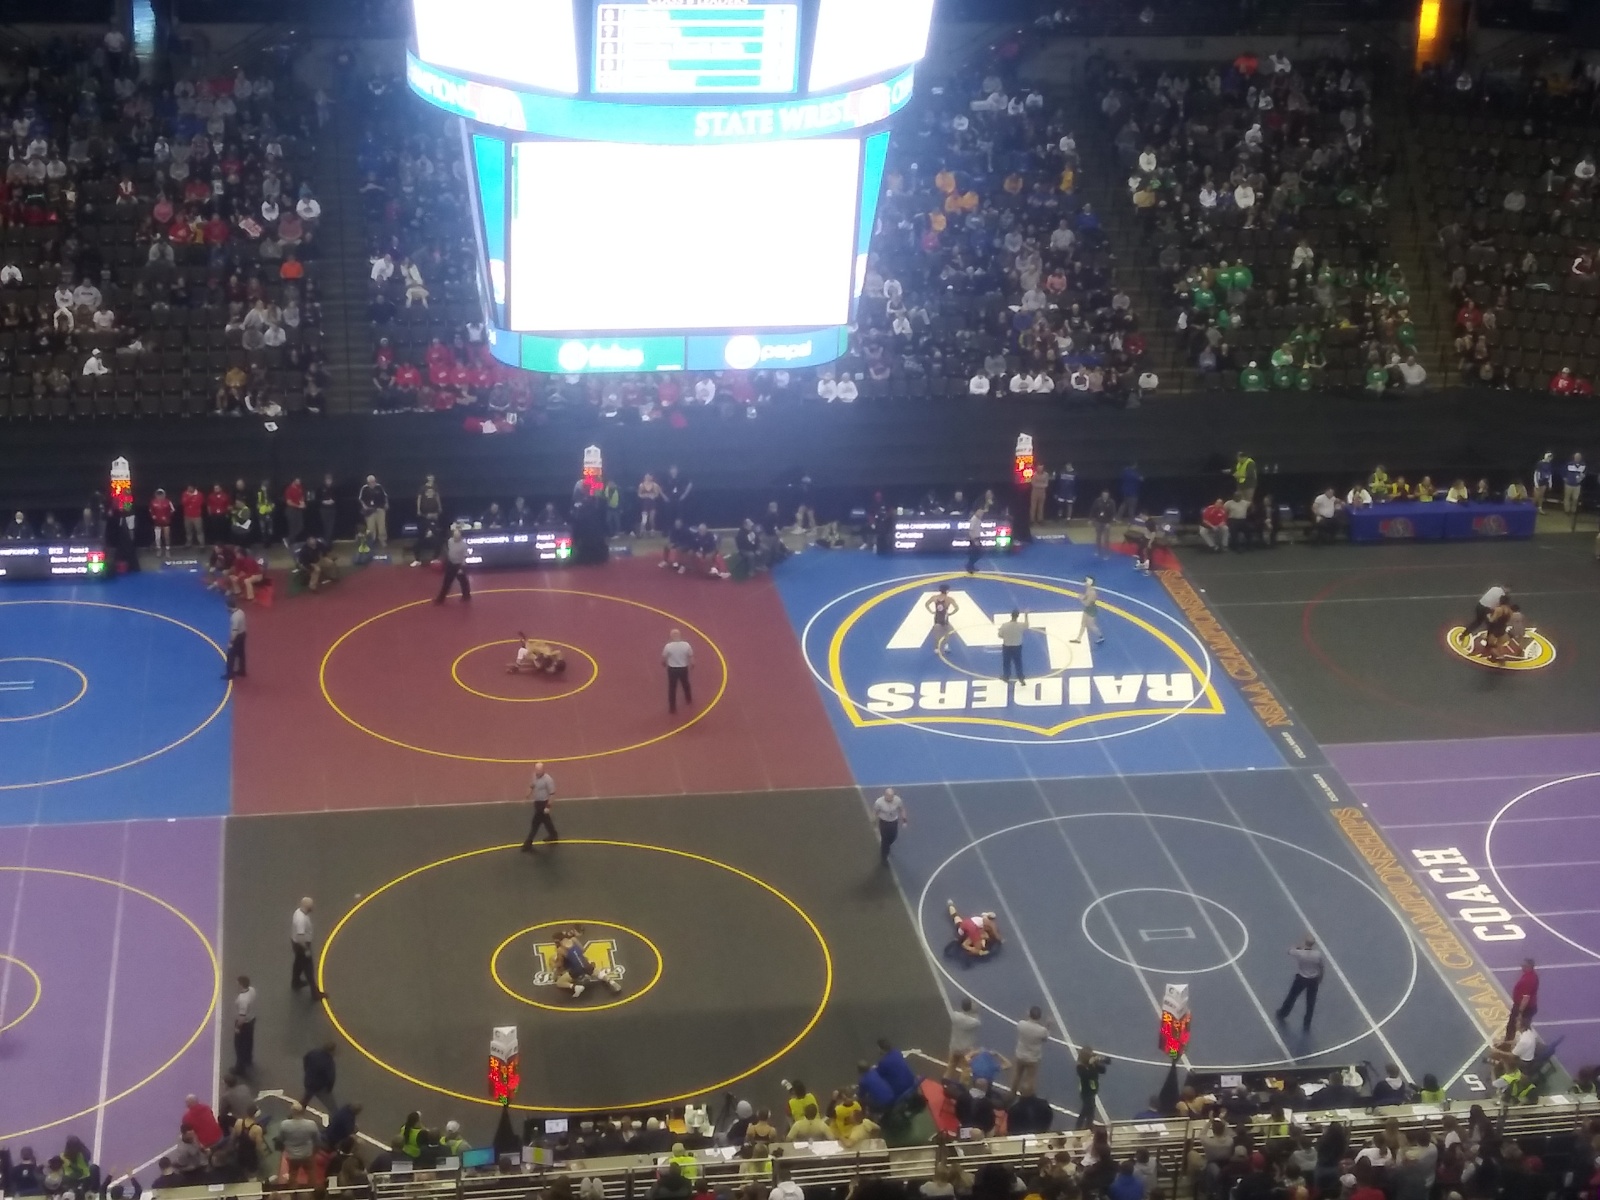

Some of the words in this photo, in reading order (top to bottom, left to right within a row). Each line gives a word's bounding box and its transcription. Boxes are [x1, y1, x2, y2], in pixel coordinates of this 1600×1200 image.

[694, 108, 774, 138] STATE
[866, 672, 1195, 713] RAIDERS
[1330, 806, 1474, 970] CHAMPIONSHIPS
[1412, 847, 1527, 941] COACH
